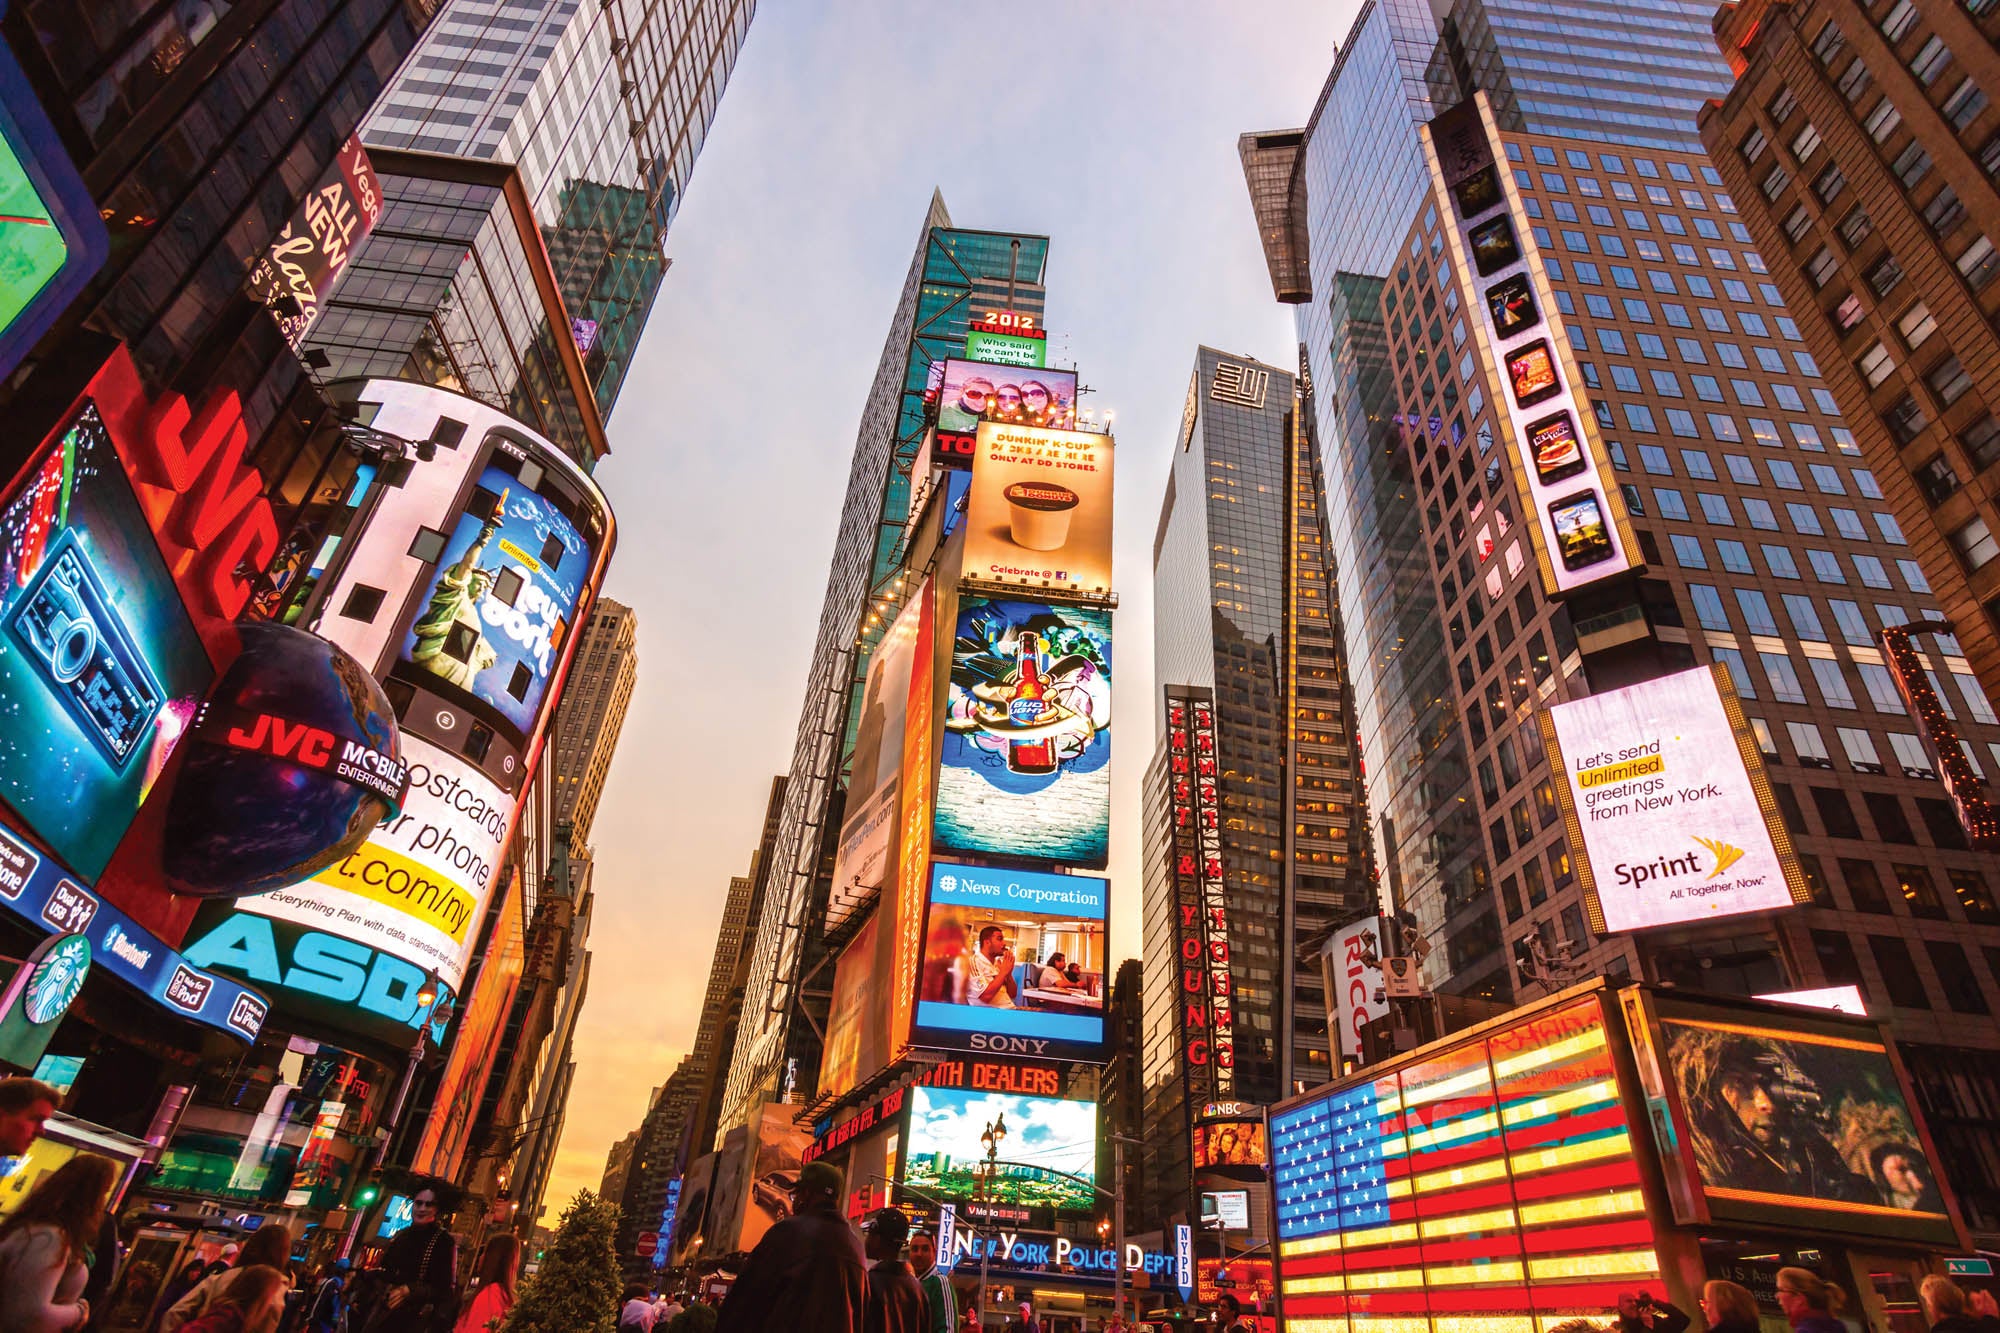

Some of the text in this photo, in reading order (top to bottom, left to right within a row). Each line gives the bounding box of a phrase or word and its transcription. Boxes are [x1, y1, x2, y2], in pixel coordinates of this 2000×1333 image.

[321, 182, 357, 246] ALL
[971, 321, 1045, 339] TOSHIBA
[985, 312, 1034, 329] 2012
[982, 338, 1032, 350] Who said
[501, 440, 527, 461] htc
[996, 433, 1049, 447] DUNKIN'
[990, 454, 1017, 463] ONLY
[1037, 459, 1053, 467] DD
[1056, 462, 1098, 472] STORES.
[155, 389, 280, 621] JVC
[501, 540, 538, 570] Unlimited
[990, 564, 1040, 577] Celebrate
[1042, 570, 1052, 579] @
[228, 714, 336, 768] JVC
[1576, 739, 1660, 771] Let's send
[341, 740, 406, 787] MOBILE
[1581, 758, 1660, 787] Unlimited
[1585, 777, 1665, 807] greetings
[1590, 783, 1723, 821] from New York.
[409, 823, 490, 890] phone.
[1614, 851, 1702, 889] Sprint
[57, 887, 76, 906] Dual
[960, 878, 1099, 906] News Corporation
[1170, 707, 1208, 1065] ERNST & YOUNG
[1686, 881, 1734, 898] Together.
[49, 902, 66, 921] USB
[270, 890, 335, 917] Everything
[337, 908, 362, 924] Plan
[363, 917, 386, 933] with
[386, 925, 407, 942] data,
[408, 936, 440, 958] standard
[178, 983, 201, 1006] iPod
[1344, 934, 1371, 1053] RICO
[970, 1033, 1050, 1055] SONY
[972, 1063, 1059, 1095] DEALERS
[1217, 1103, 1241, 1115] NBC
[975, 1207, 999, 1217] Meia
[941, 1206, 953, 1264] NYPD
[1180, 1227, 1189, 1285] NYPD
